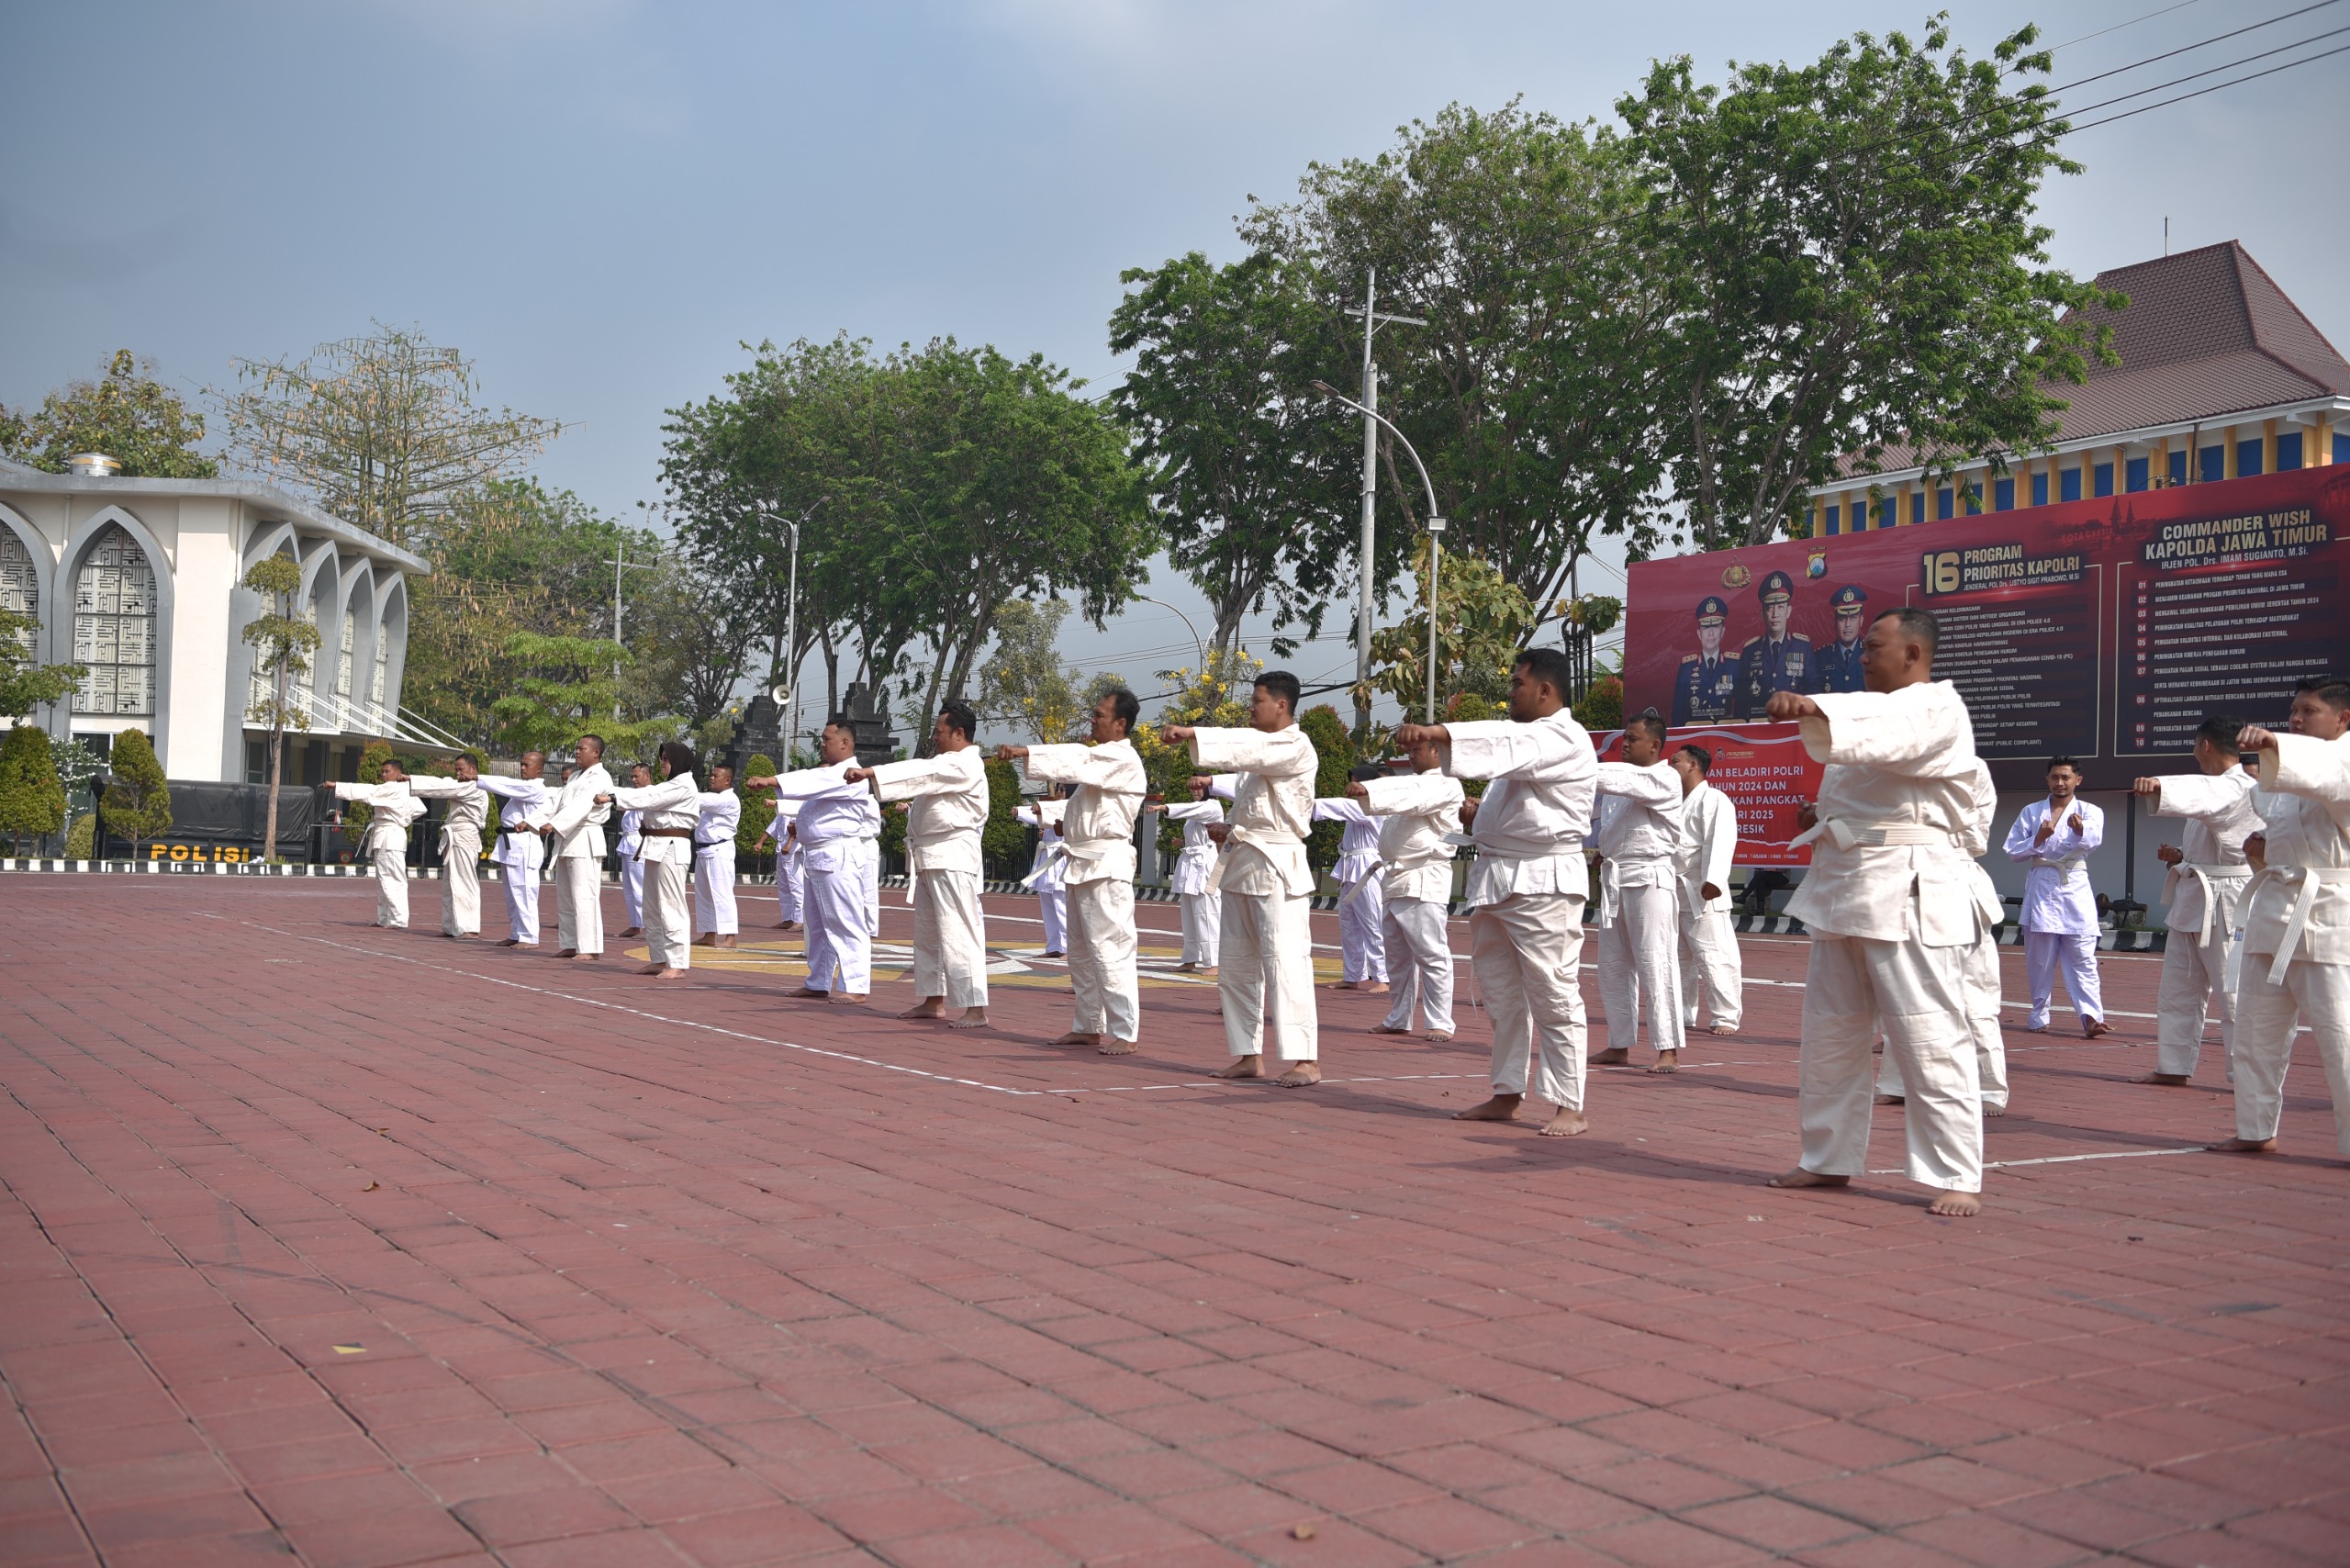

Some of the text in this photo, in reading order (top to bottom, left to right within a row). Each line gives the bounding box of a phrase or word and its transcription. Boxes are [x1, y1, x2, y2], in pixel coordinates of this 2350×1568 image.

[2163, 509, 2311, 541] COMMANDER WISH
[2145, 523, 2328, 560] KAPOLDA JAWA TIMUR
[1964, 544, 2023, 565] PROGRAM
[2161, 545, 2309, 570] IRJEN POL. Drs. IMAM SUGIANTO, M.Si.
[1923, 551, 1961, 594] 16
[1964, 555, 2080, 582] PRIORITAS KAPOLRI
[2235, 573, 2251, 581] TUHAN
[2251, 571, 2264, 579] YANG
[2263, 570, 2277, 578] MAHA
[1964, 583, 1987, 591] JENDERAL
[2009, 577, 2027, 587] LISTYO
[2028, 577, 2040, 585] SIGIT
[2041, 575, 2068, 584] PRABOWO,
[2222, 588, 2246, 597] PRIORITAS
[2246, 586, 2269, 595] NASIONAL
[2275, 584, 2289, 592] JAWA
[2289, 582, 2306, 590] TIMUR
[2138, 610, 2146, 618] 03
[2199, 605, 2225, 613] RANGKAIAN
[2266, 599, 2290, 608] SERENTAK
[2290, 598, 2306, 606] TAHUN
[2244, 616, 2268, 624] TERHADAP
[2268, 613, 2300, 622] MASYARAKAT
[2002, 629, 2022, 637] MODERN
[2201, 634, 2223, 643] INTERNAL
[2233, 632, 2262, 640] KOLABORASI
[2229, 662, 2249, 670] COOLING
[2249, 661, 2268, 669] SYSTEM
[2285, 659, 2305, 667] RANGKA
[2304, 657, 2328, 666] MENJAGA
[2245, 691, 2256, 700] DAN
[1725, 767, 1771, 778] BELADIRI
[1773, 766, 1804, 777] POLRI
[1738, 781, 1762, 791] 2024
[1764, 780, 1787, 790] DAN
[1755, 794, 1806, 806] PANGKAT
[1750, 810, 1774, 820] 2025
[1737, 823, 1765, 834] RESIK
[151, 844, 250, 863] POLISI
